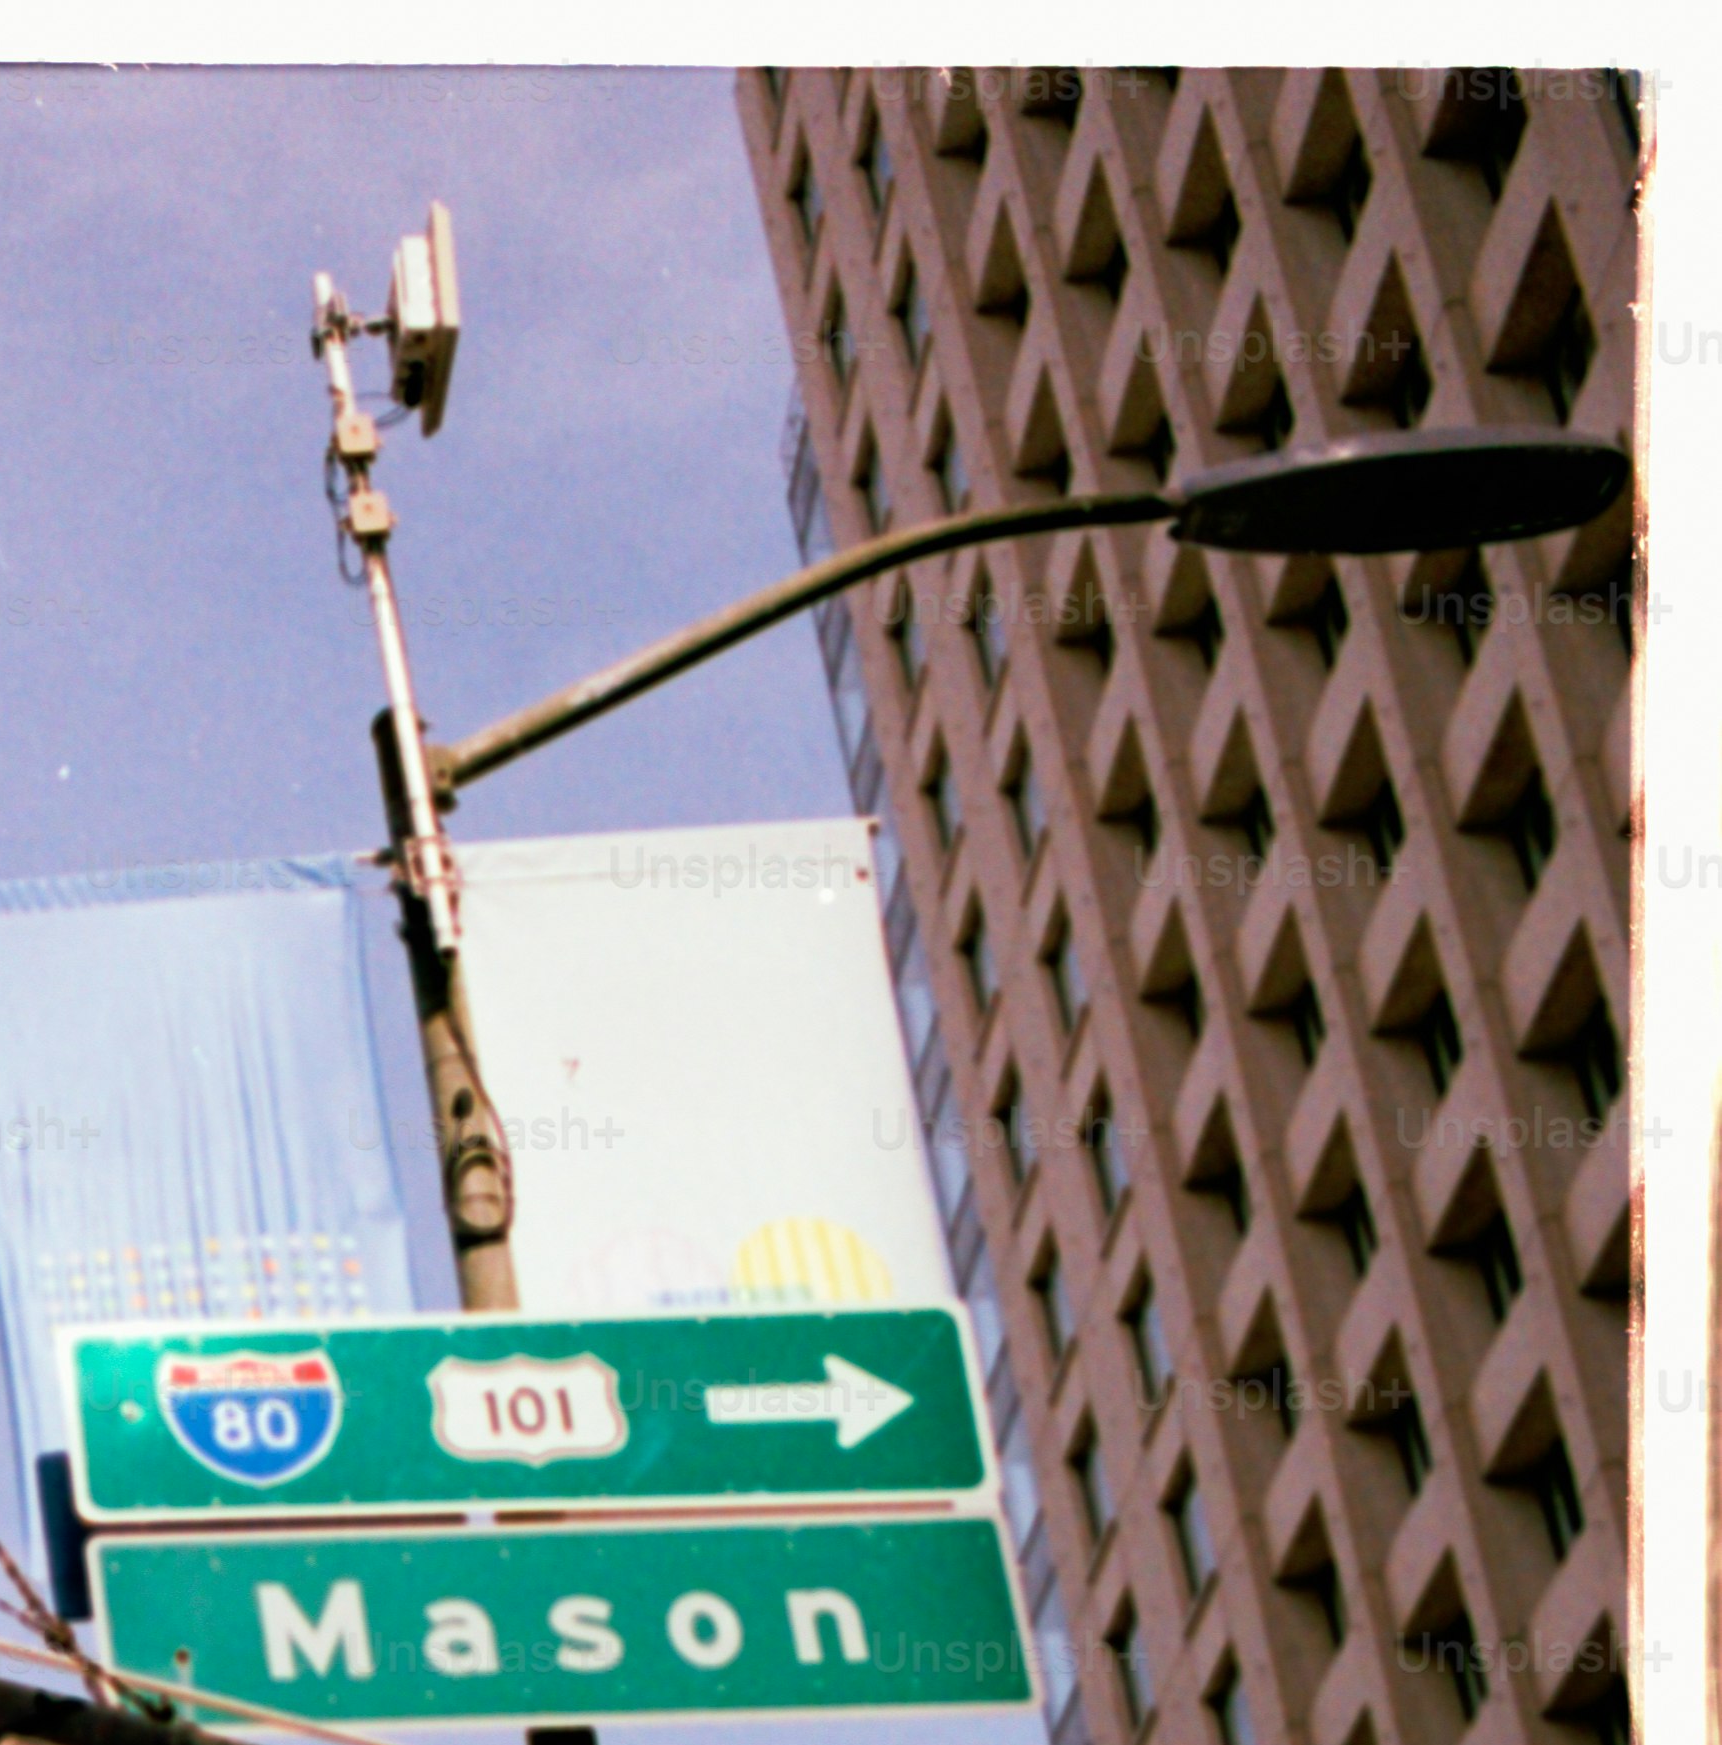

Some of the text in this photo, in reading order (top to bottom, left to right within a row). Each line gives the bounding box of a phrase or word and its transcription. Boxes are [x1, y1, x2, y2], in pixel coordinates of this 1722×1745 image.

[212, 1399, 299, 1450] 80
[483, 1385, 574, 1436] 101
[256, 1579, 870, 1681] Mason
